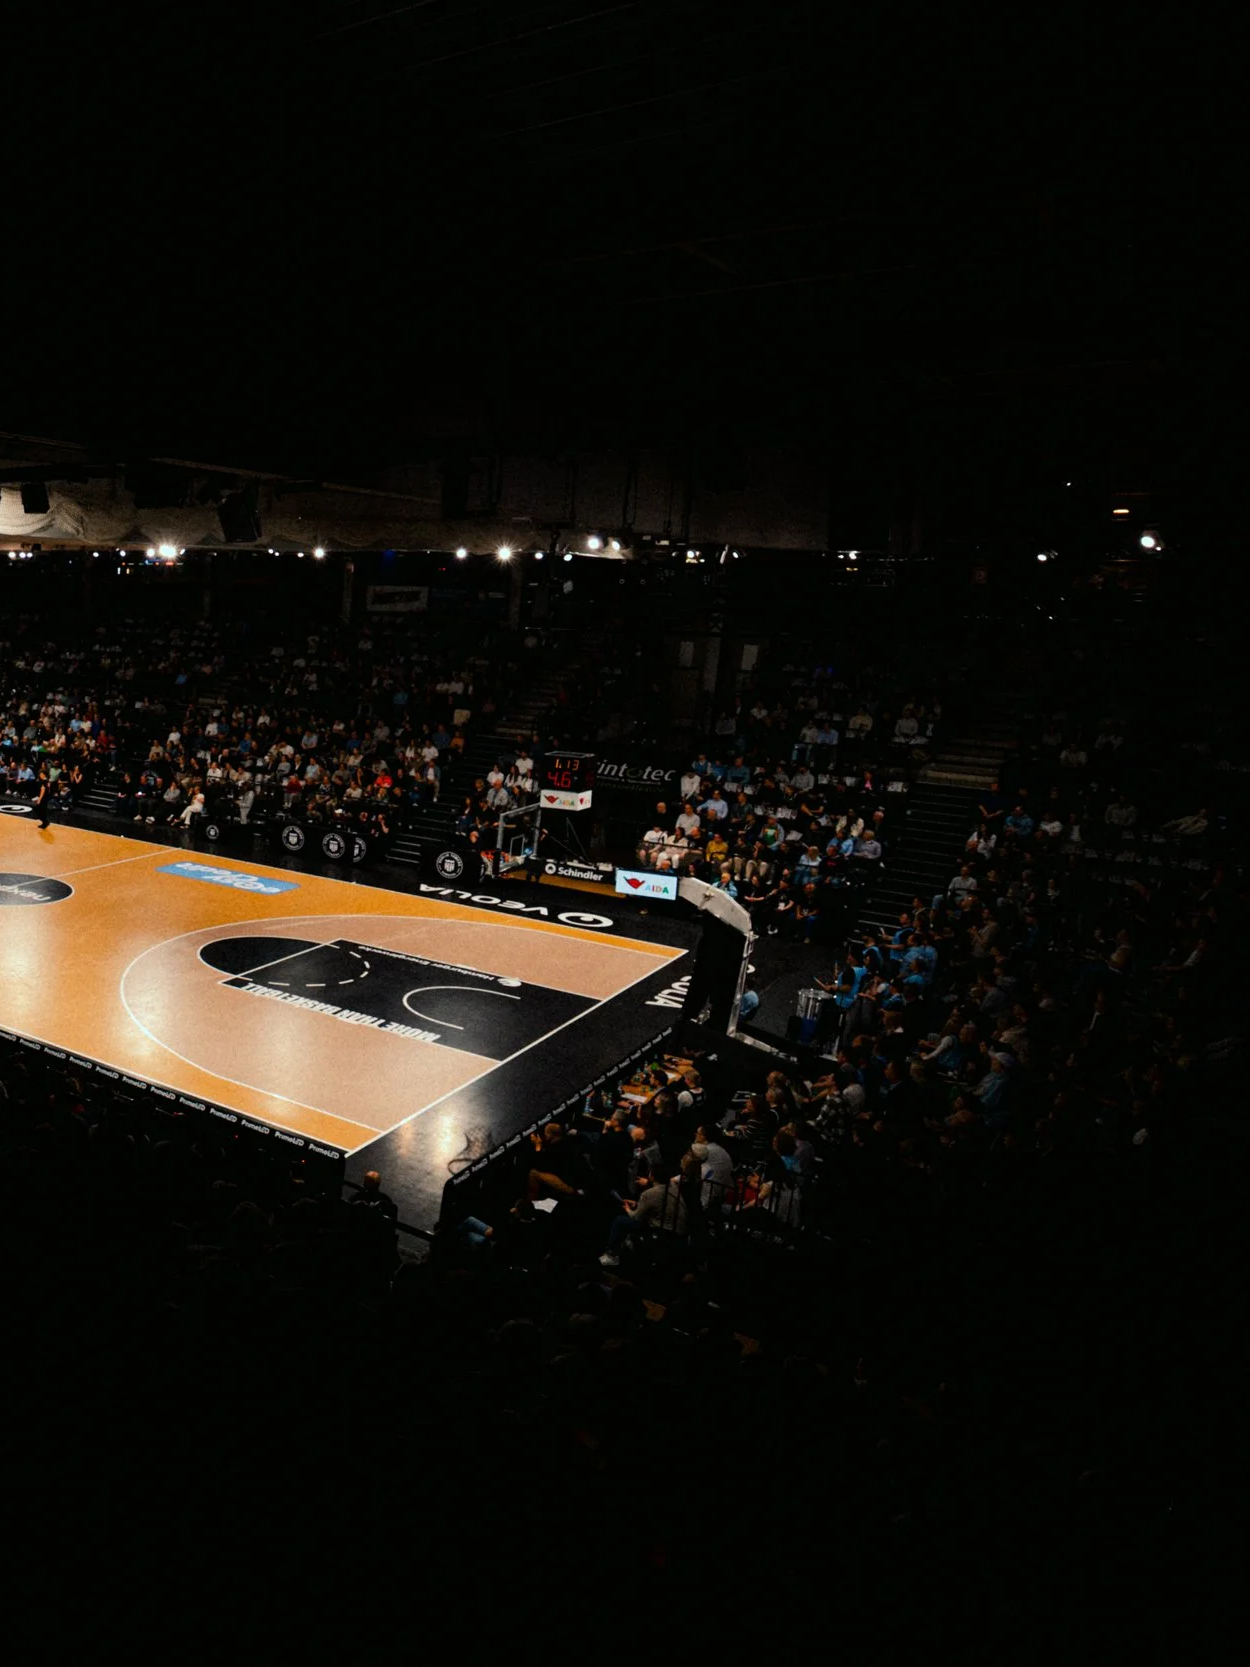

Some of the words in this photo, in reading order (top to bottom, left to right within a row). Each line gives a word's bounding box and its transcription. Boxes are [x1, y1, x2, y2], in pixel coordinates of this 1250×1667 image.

[557, 866, 604, 881] Schindler
[419, 883, 549, 916] VEOLIA
[645, 884, 669, 895] AIDA
[241, 982, 343, 1018] BASKETBALL
[385, 1021, 441, 1042] MORE
